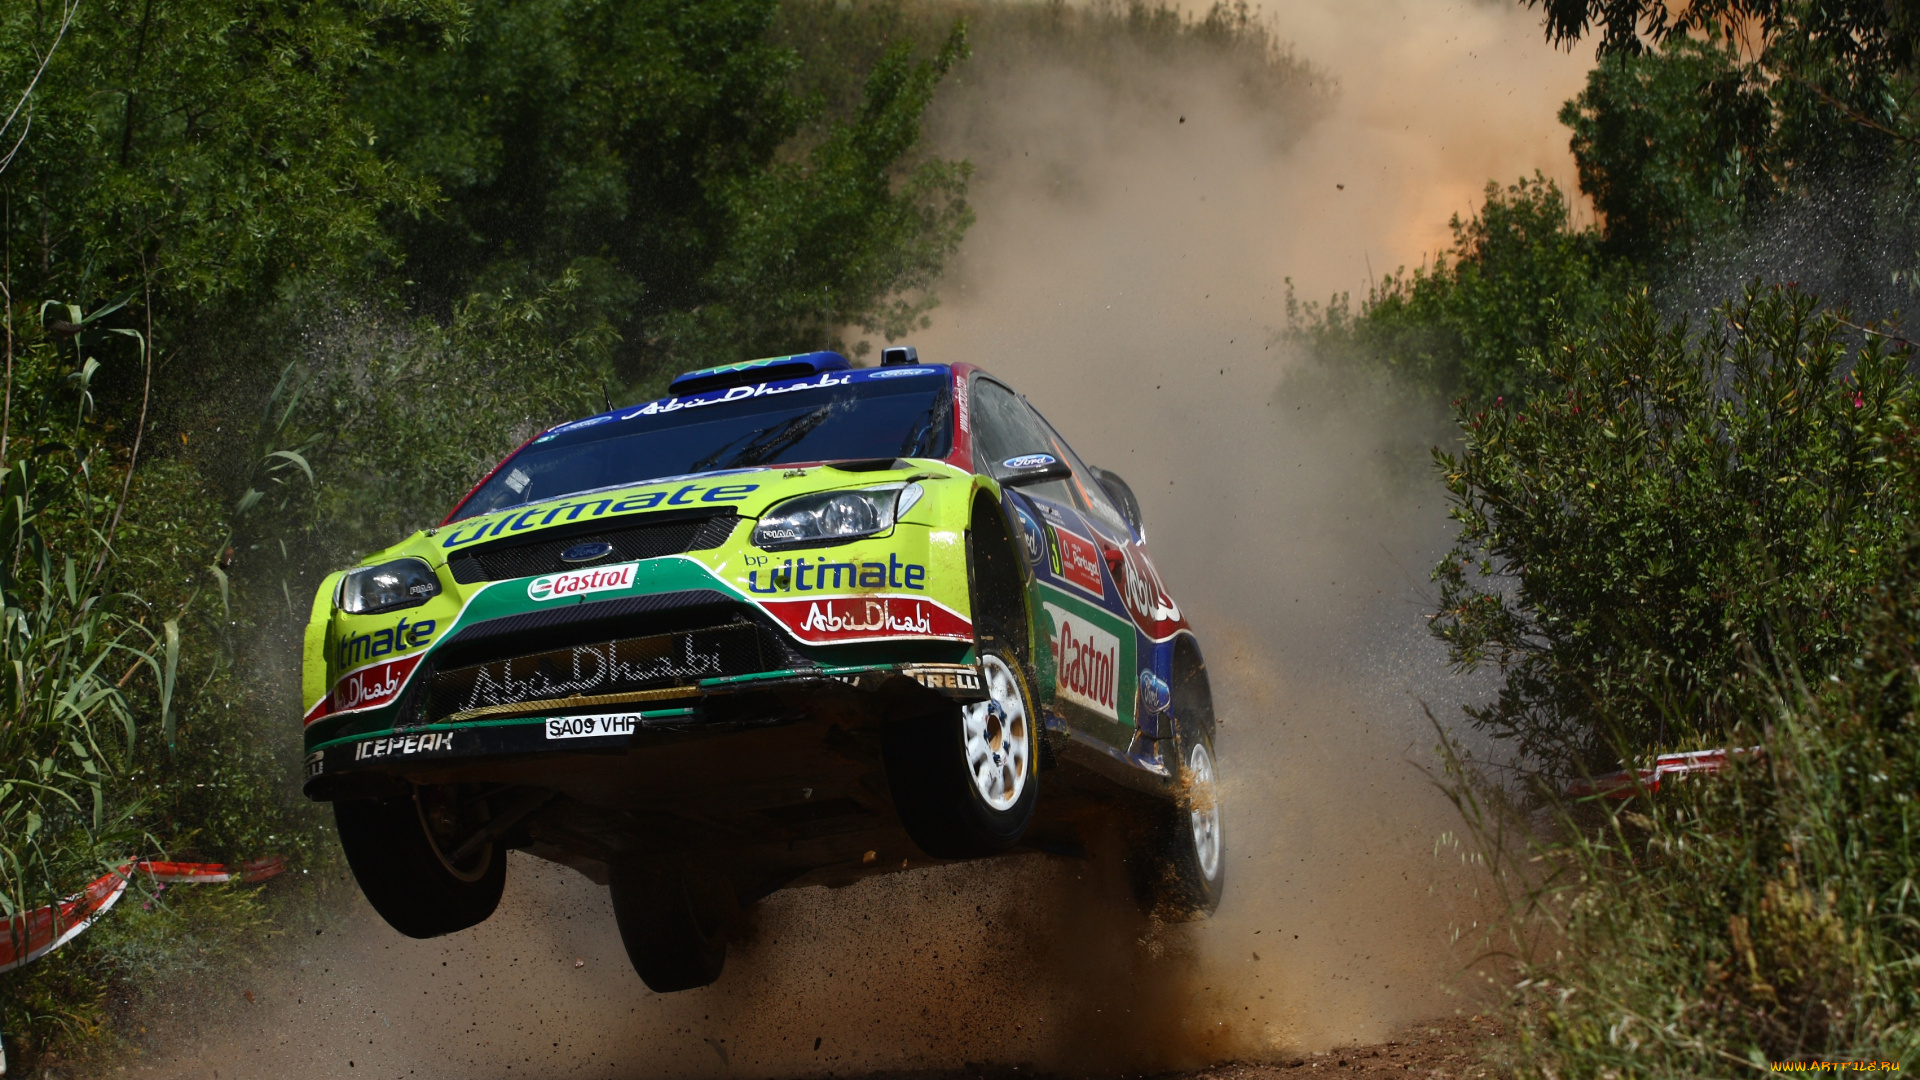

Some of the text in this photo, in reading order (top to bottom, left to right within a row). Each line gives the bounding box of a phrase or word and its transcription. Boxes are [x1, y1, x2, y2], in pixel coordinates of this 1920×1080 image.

[1013, 456, 1047, 467] Ford
[443, 484, 760, 548] ultimate
[763, 529, 795, 539] PIAA
[744, 554, 768, 568] bp
[749, 552, 925, 594] ultimate
[1072, 551, 1100, 577] Portugal
[410, 583, 434, 594] PIAA
[553, 567, 630, 595] Castrol
[337, 617, 436, 671] ltimate
[1060, 621, 1115, 709] Castrol
[549, 717, 595, 737] SA09
[355, 731, 454, 761] ICEPEAK
